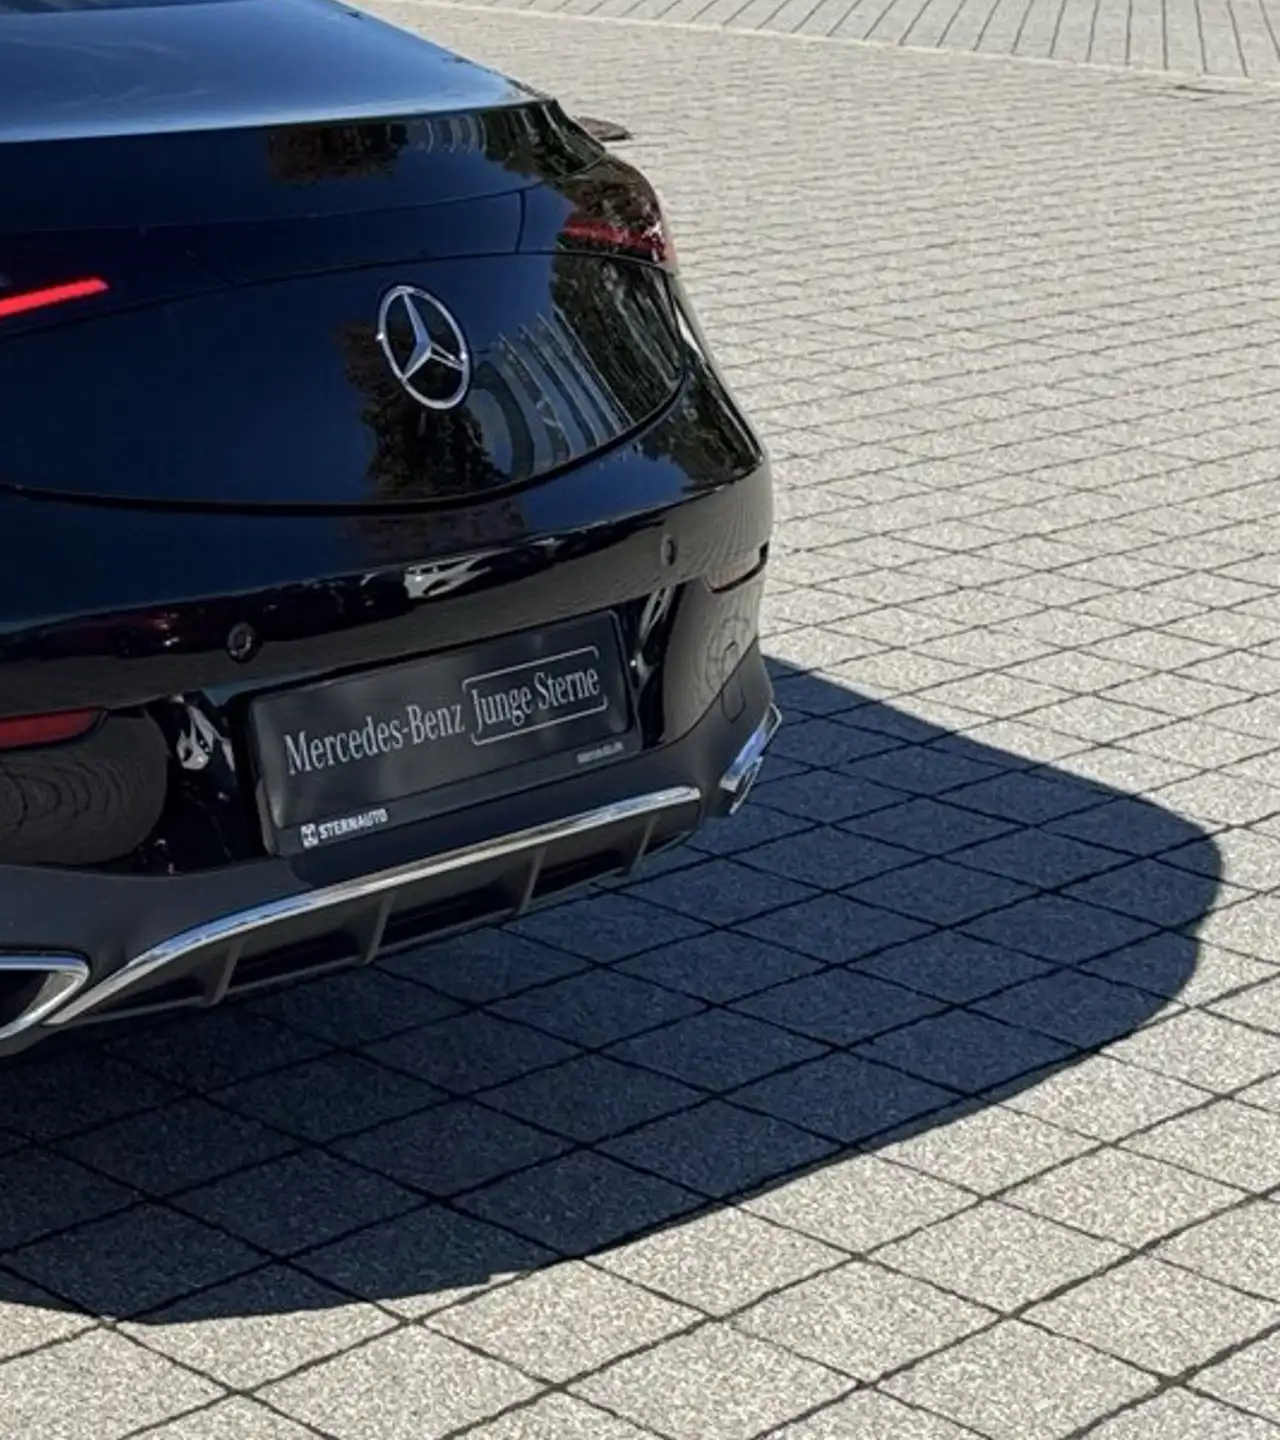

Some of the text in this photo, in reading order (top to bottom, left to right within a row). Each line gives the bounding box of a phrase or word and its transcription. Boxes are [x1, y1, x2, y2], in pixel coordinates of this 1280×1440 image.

[284, 667, 600, 776] Mercedes-Benz Junge Sterne
[318, 808, 389, 840] STERNAUTO
